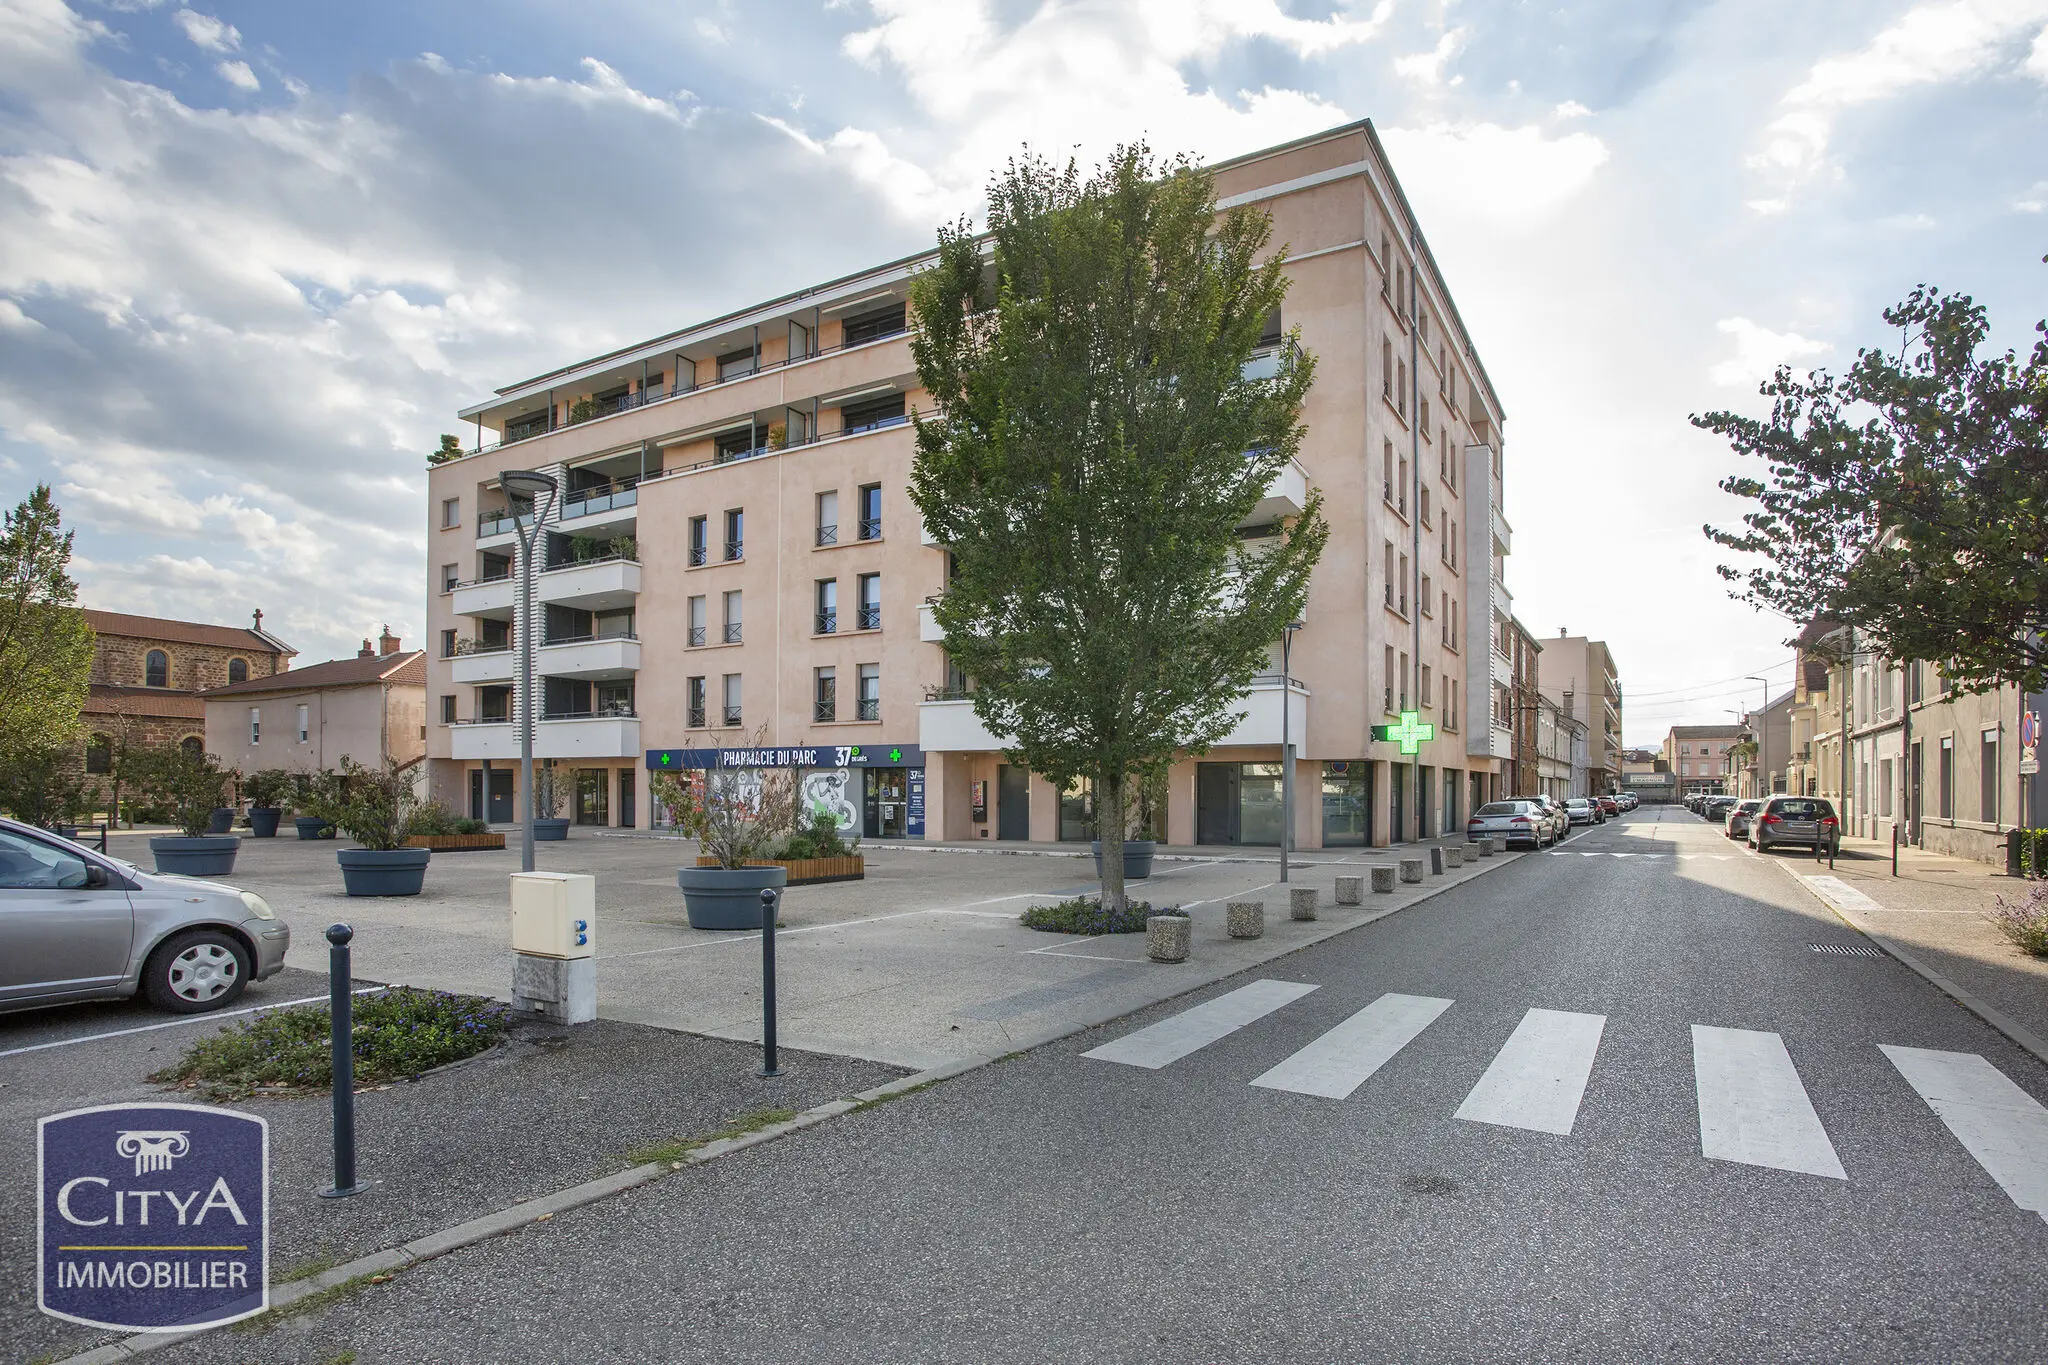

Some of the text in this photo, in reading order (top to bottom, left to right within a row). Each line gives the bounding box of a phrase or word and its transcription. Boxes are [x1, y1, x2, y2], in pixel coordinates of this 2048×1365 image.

[723, 749, 817, 766] PHARMACIE DU PARC
